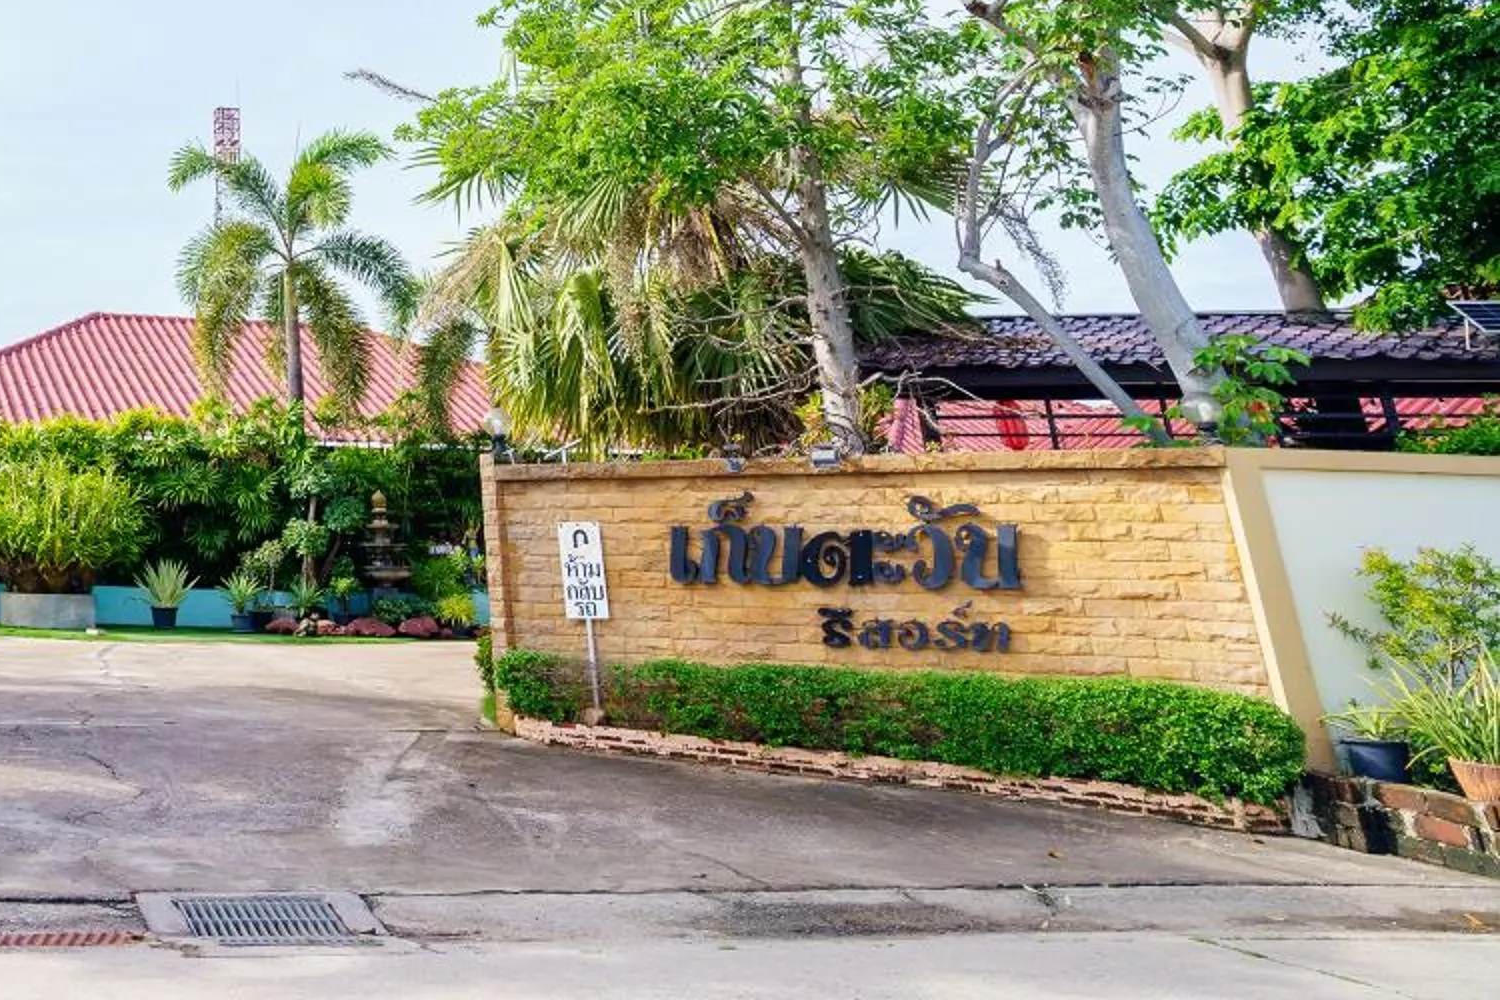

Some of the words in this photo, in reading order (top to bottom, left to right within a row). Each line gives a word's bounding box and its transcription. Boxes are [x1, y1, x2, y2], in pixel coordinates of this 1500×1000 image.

[670, 490, 1022, 590] เก็บตะวัน
[564, 553, 601, 578] ห้าม
[574, 601, 597, 617] รถ
[818, 600, 1011, 653] รีสอร์ท
